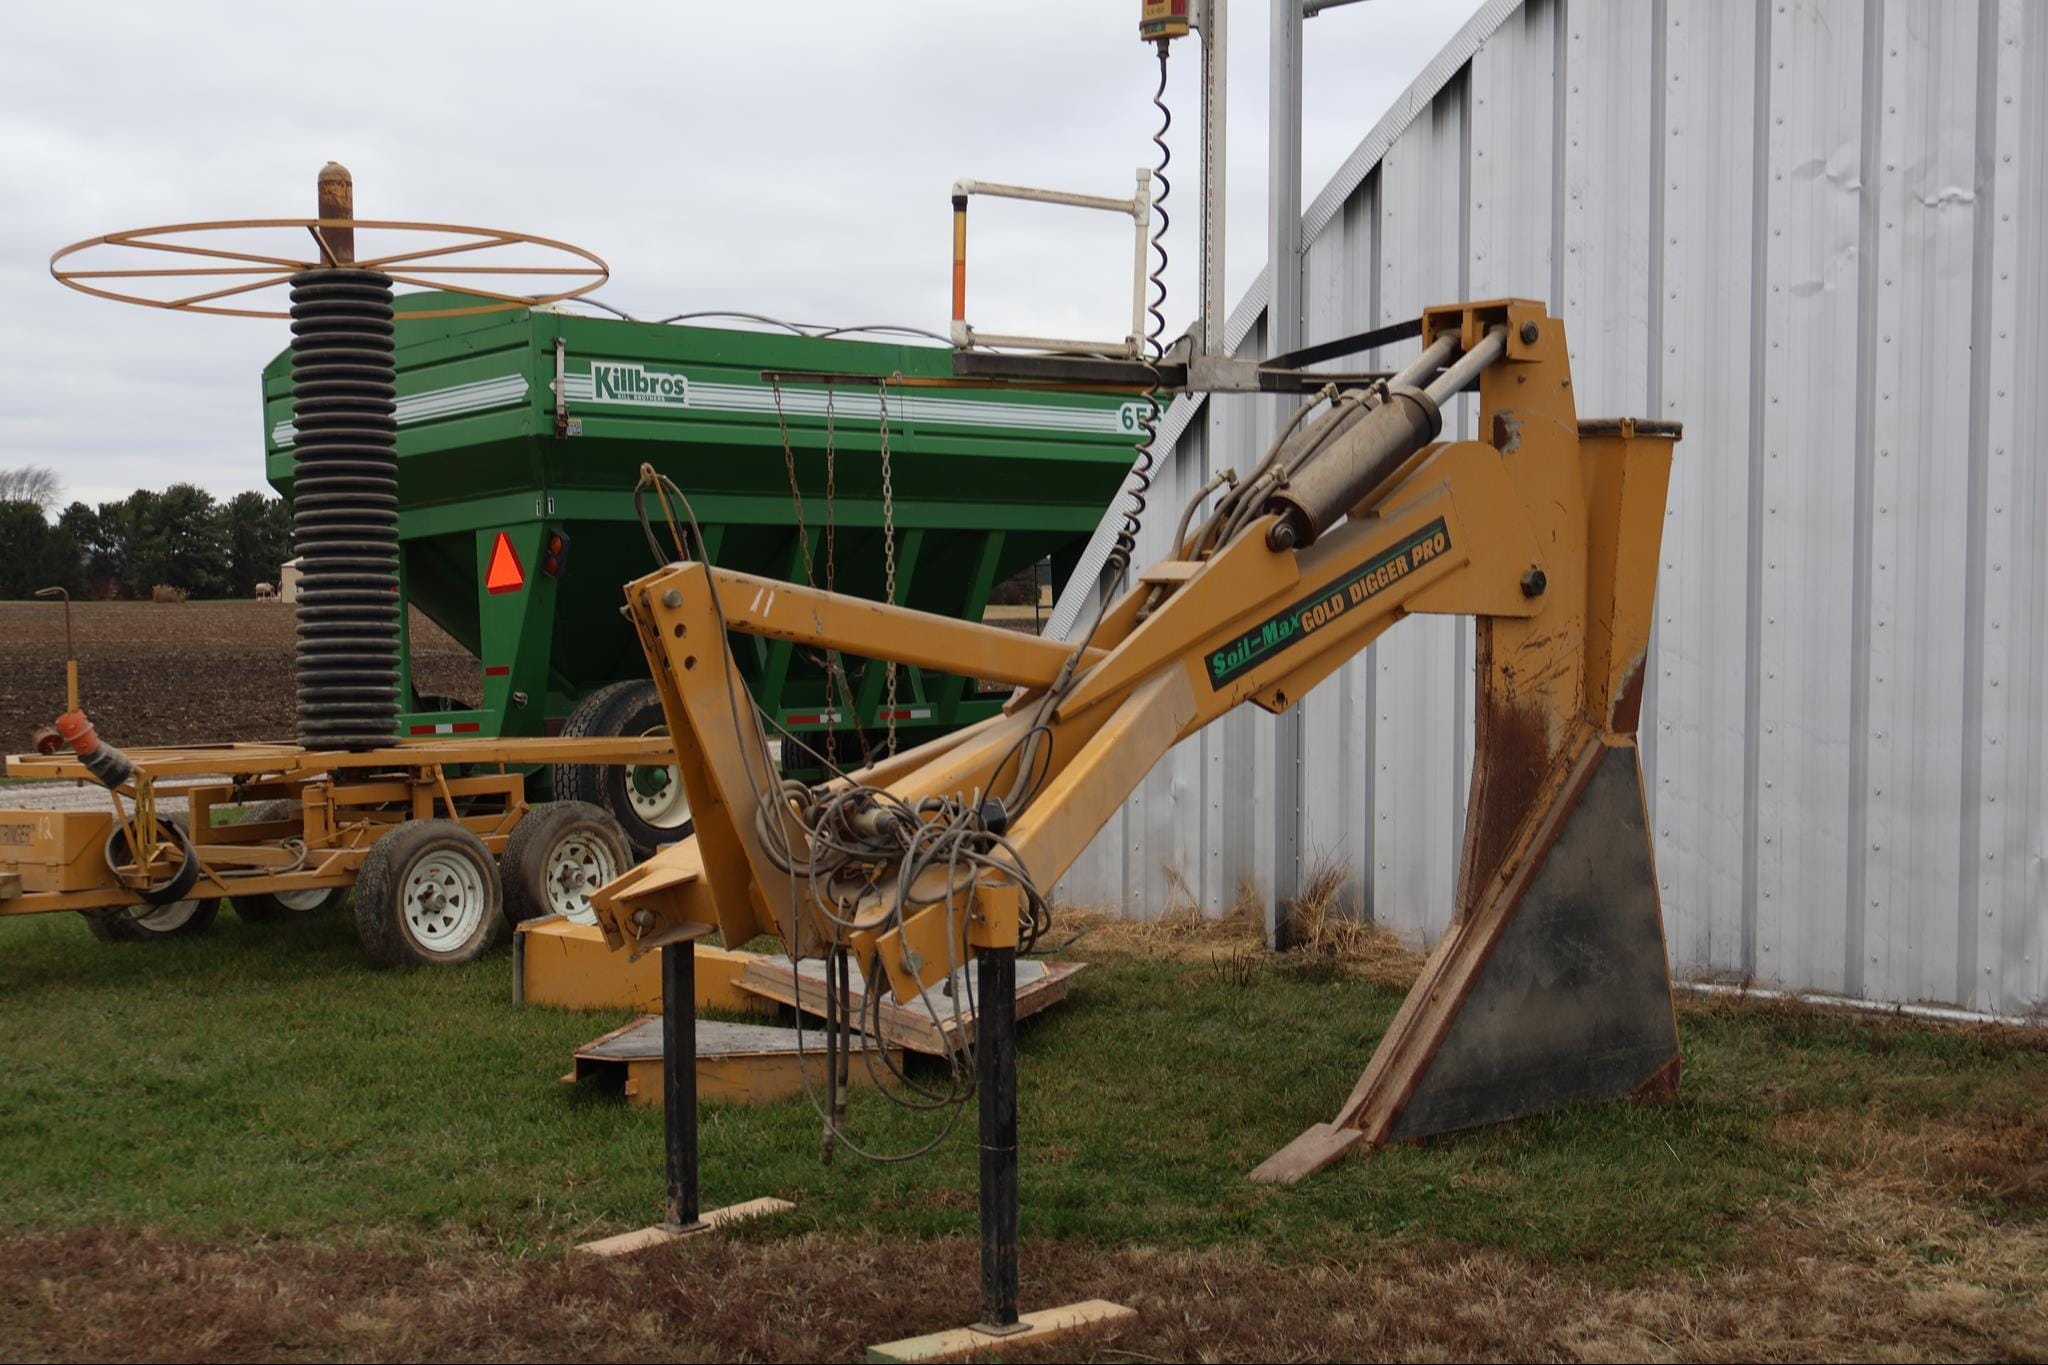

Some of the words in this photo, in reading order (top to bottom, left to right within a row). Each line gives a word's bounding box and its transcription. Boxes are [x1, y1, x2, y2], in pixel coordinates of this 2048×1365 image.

[595, 367, 685, 399] Killbros
[1213, 611, 1300, 676] Soil-Max
[1301, 593, 1344, 633] GOLD
[1349, 557, 1409, 605] DIGGER
[1412, 532, 1445, 567] PRO
